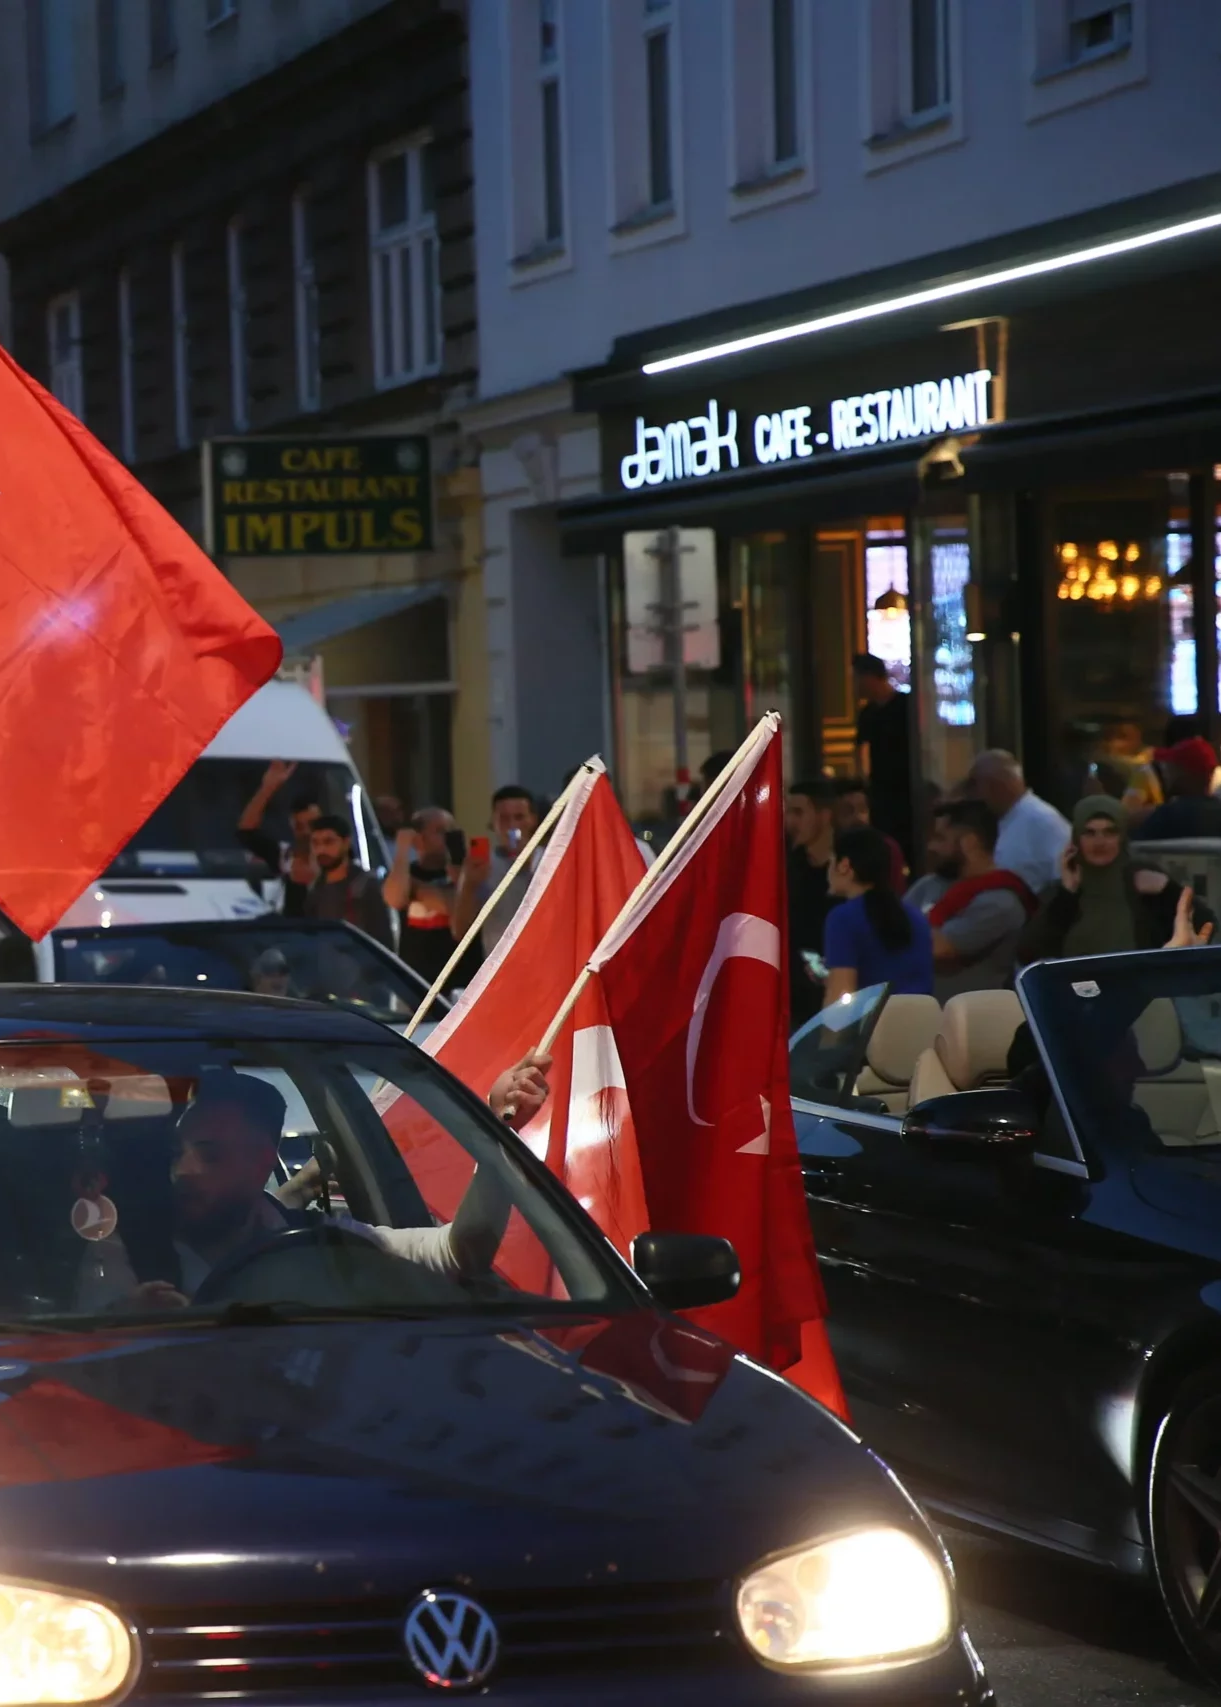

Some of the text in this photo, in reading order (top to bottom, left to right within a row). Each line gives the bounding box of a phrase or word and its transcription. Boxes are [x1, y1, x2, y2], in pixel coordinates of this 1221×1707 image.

[620, 398, 740, 490] damak
[222, 475, 420, 505] RESTAURANT
[224, 507, 424, 553] IMPULS
[405, 1592, 498, 1686] VW
